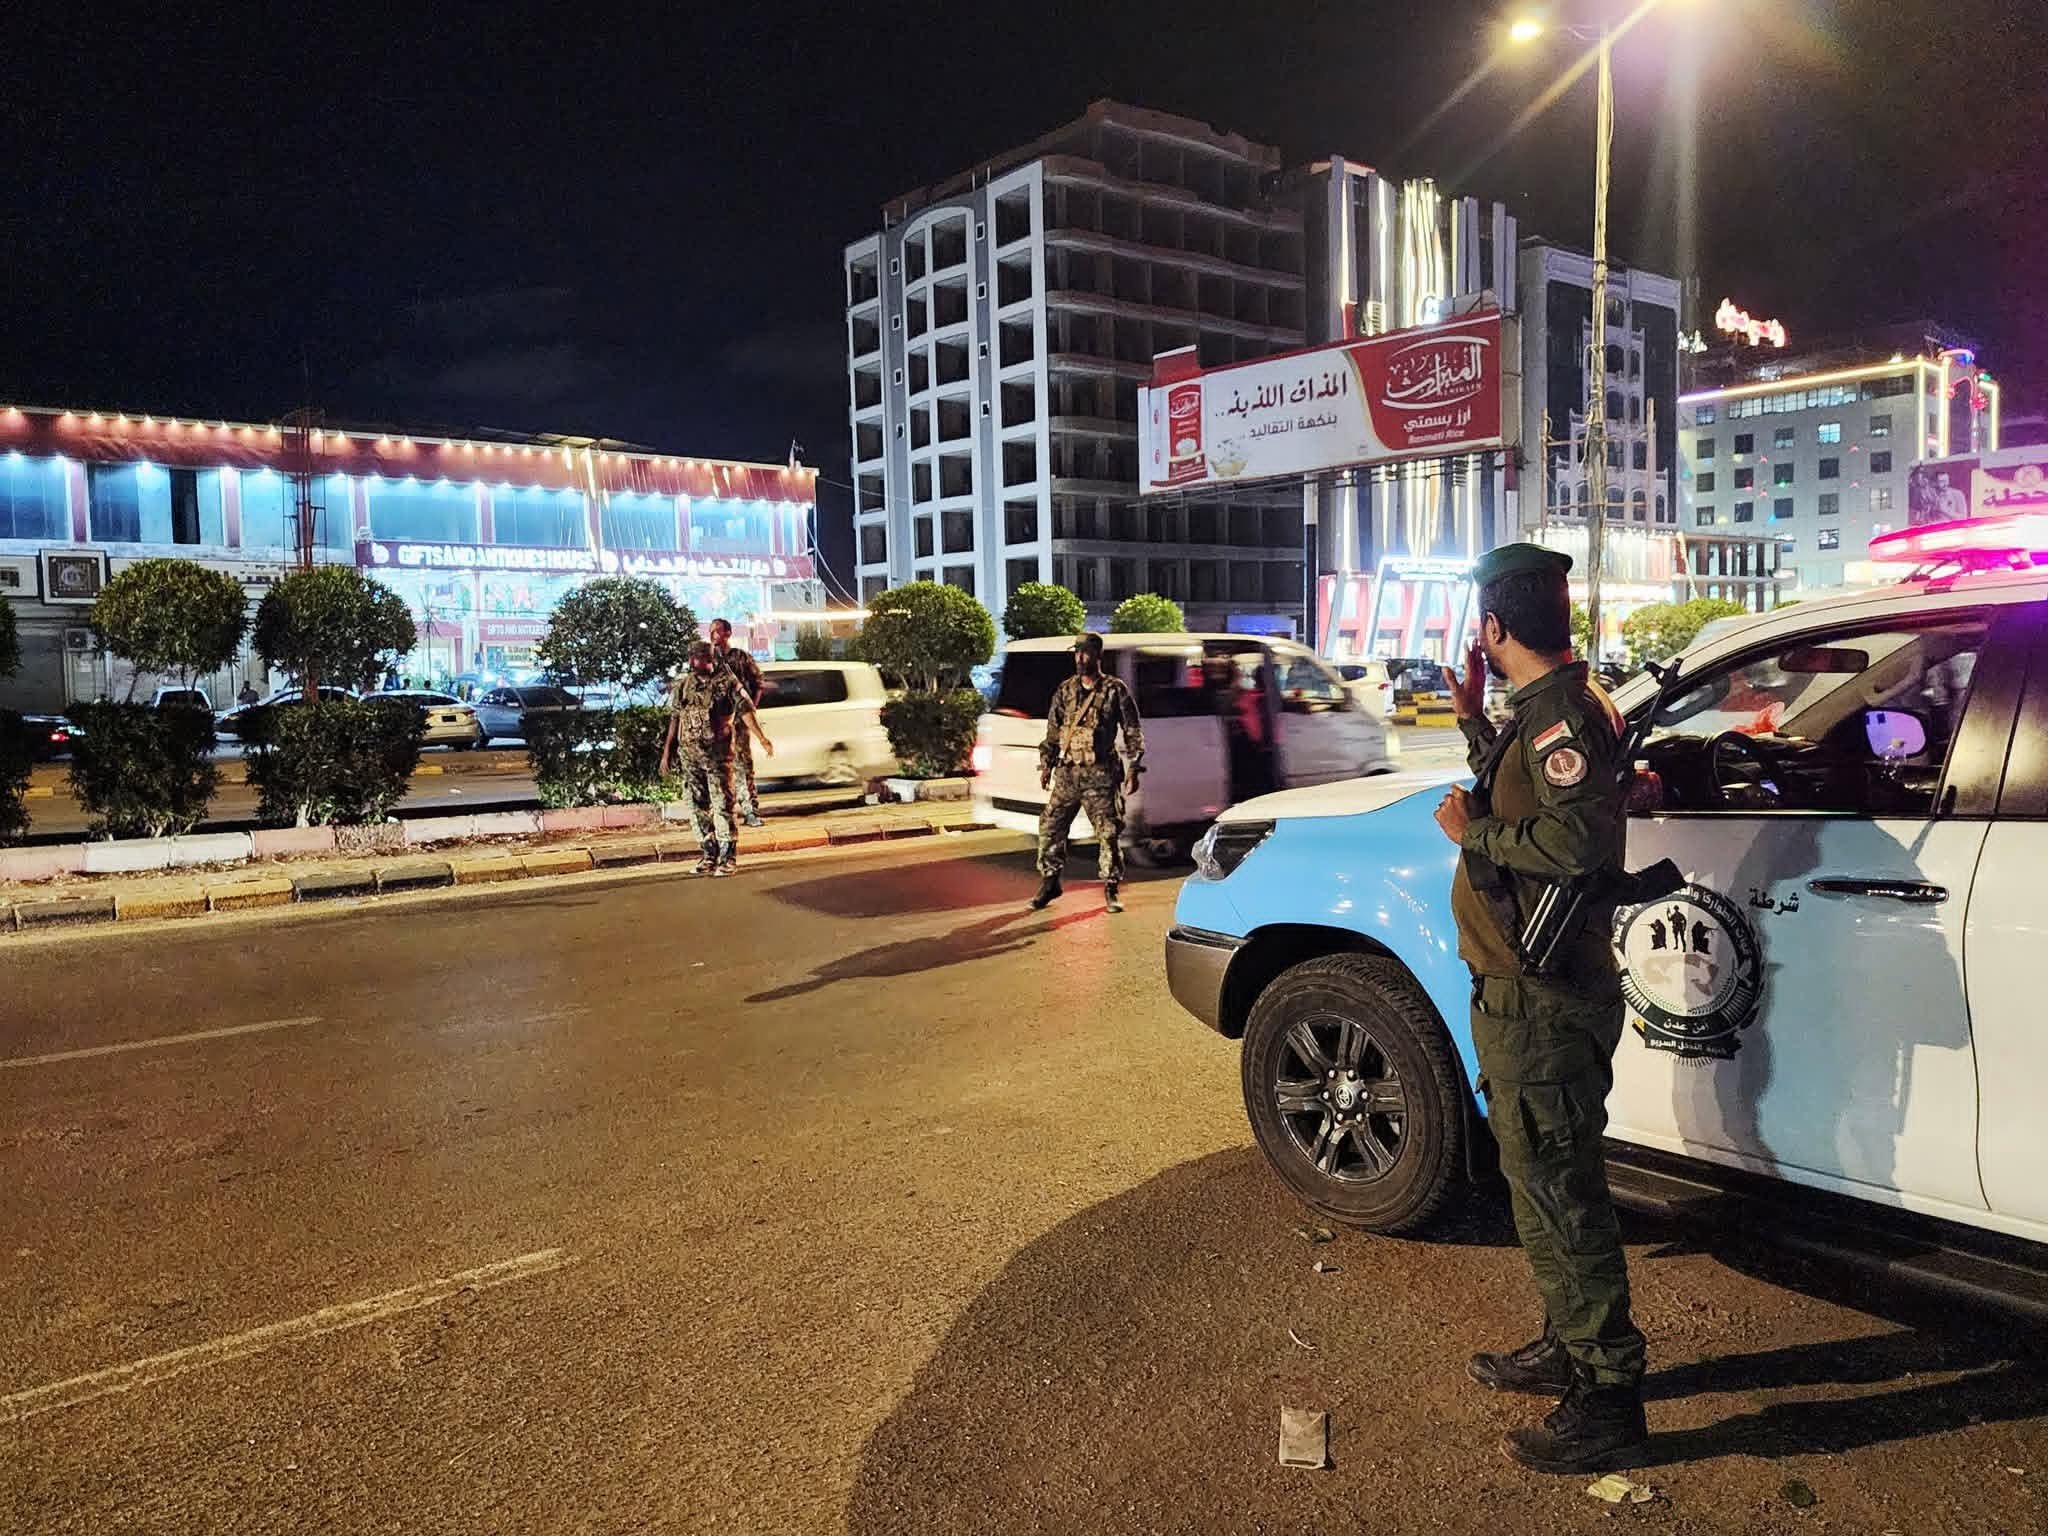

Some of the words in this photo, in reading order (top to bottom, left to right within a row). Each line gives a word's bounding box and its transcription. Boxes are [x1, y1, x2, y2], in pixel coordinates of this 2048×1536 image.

[1289, 370, 1347, 403] المذاق
[1297, 411, 1338, 432] بنكهة
[1403, 414, 1452, 433] بسمتي
[1750, 888, 1800, 916] شرطة
[1663, 1018, 1688, 1031] عدن
